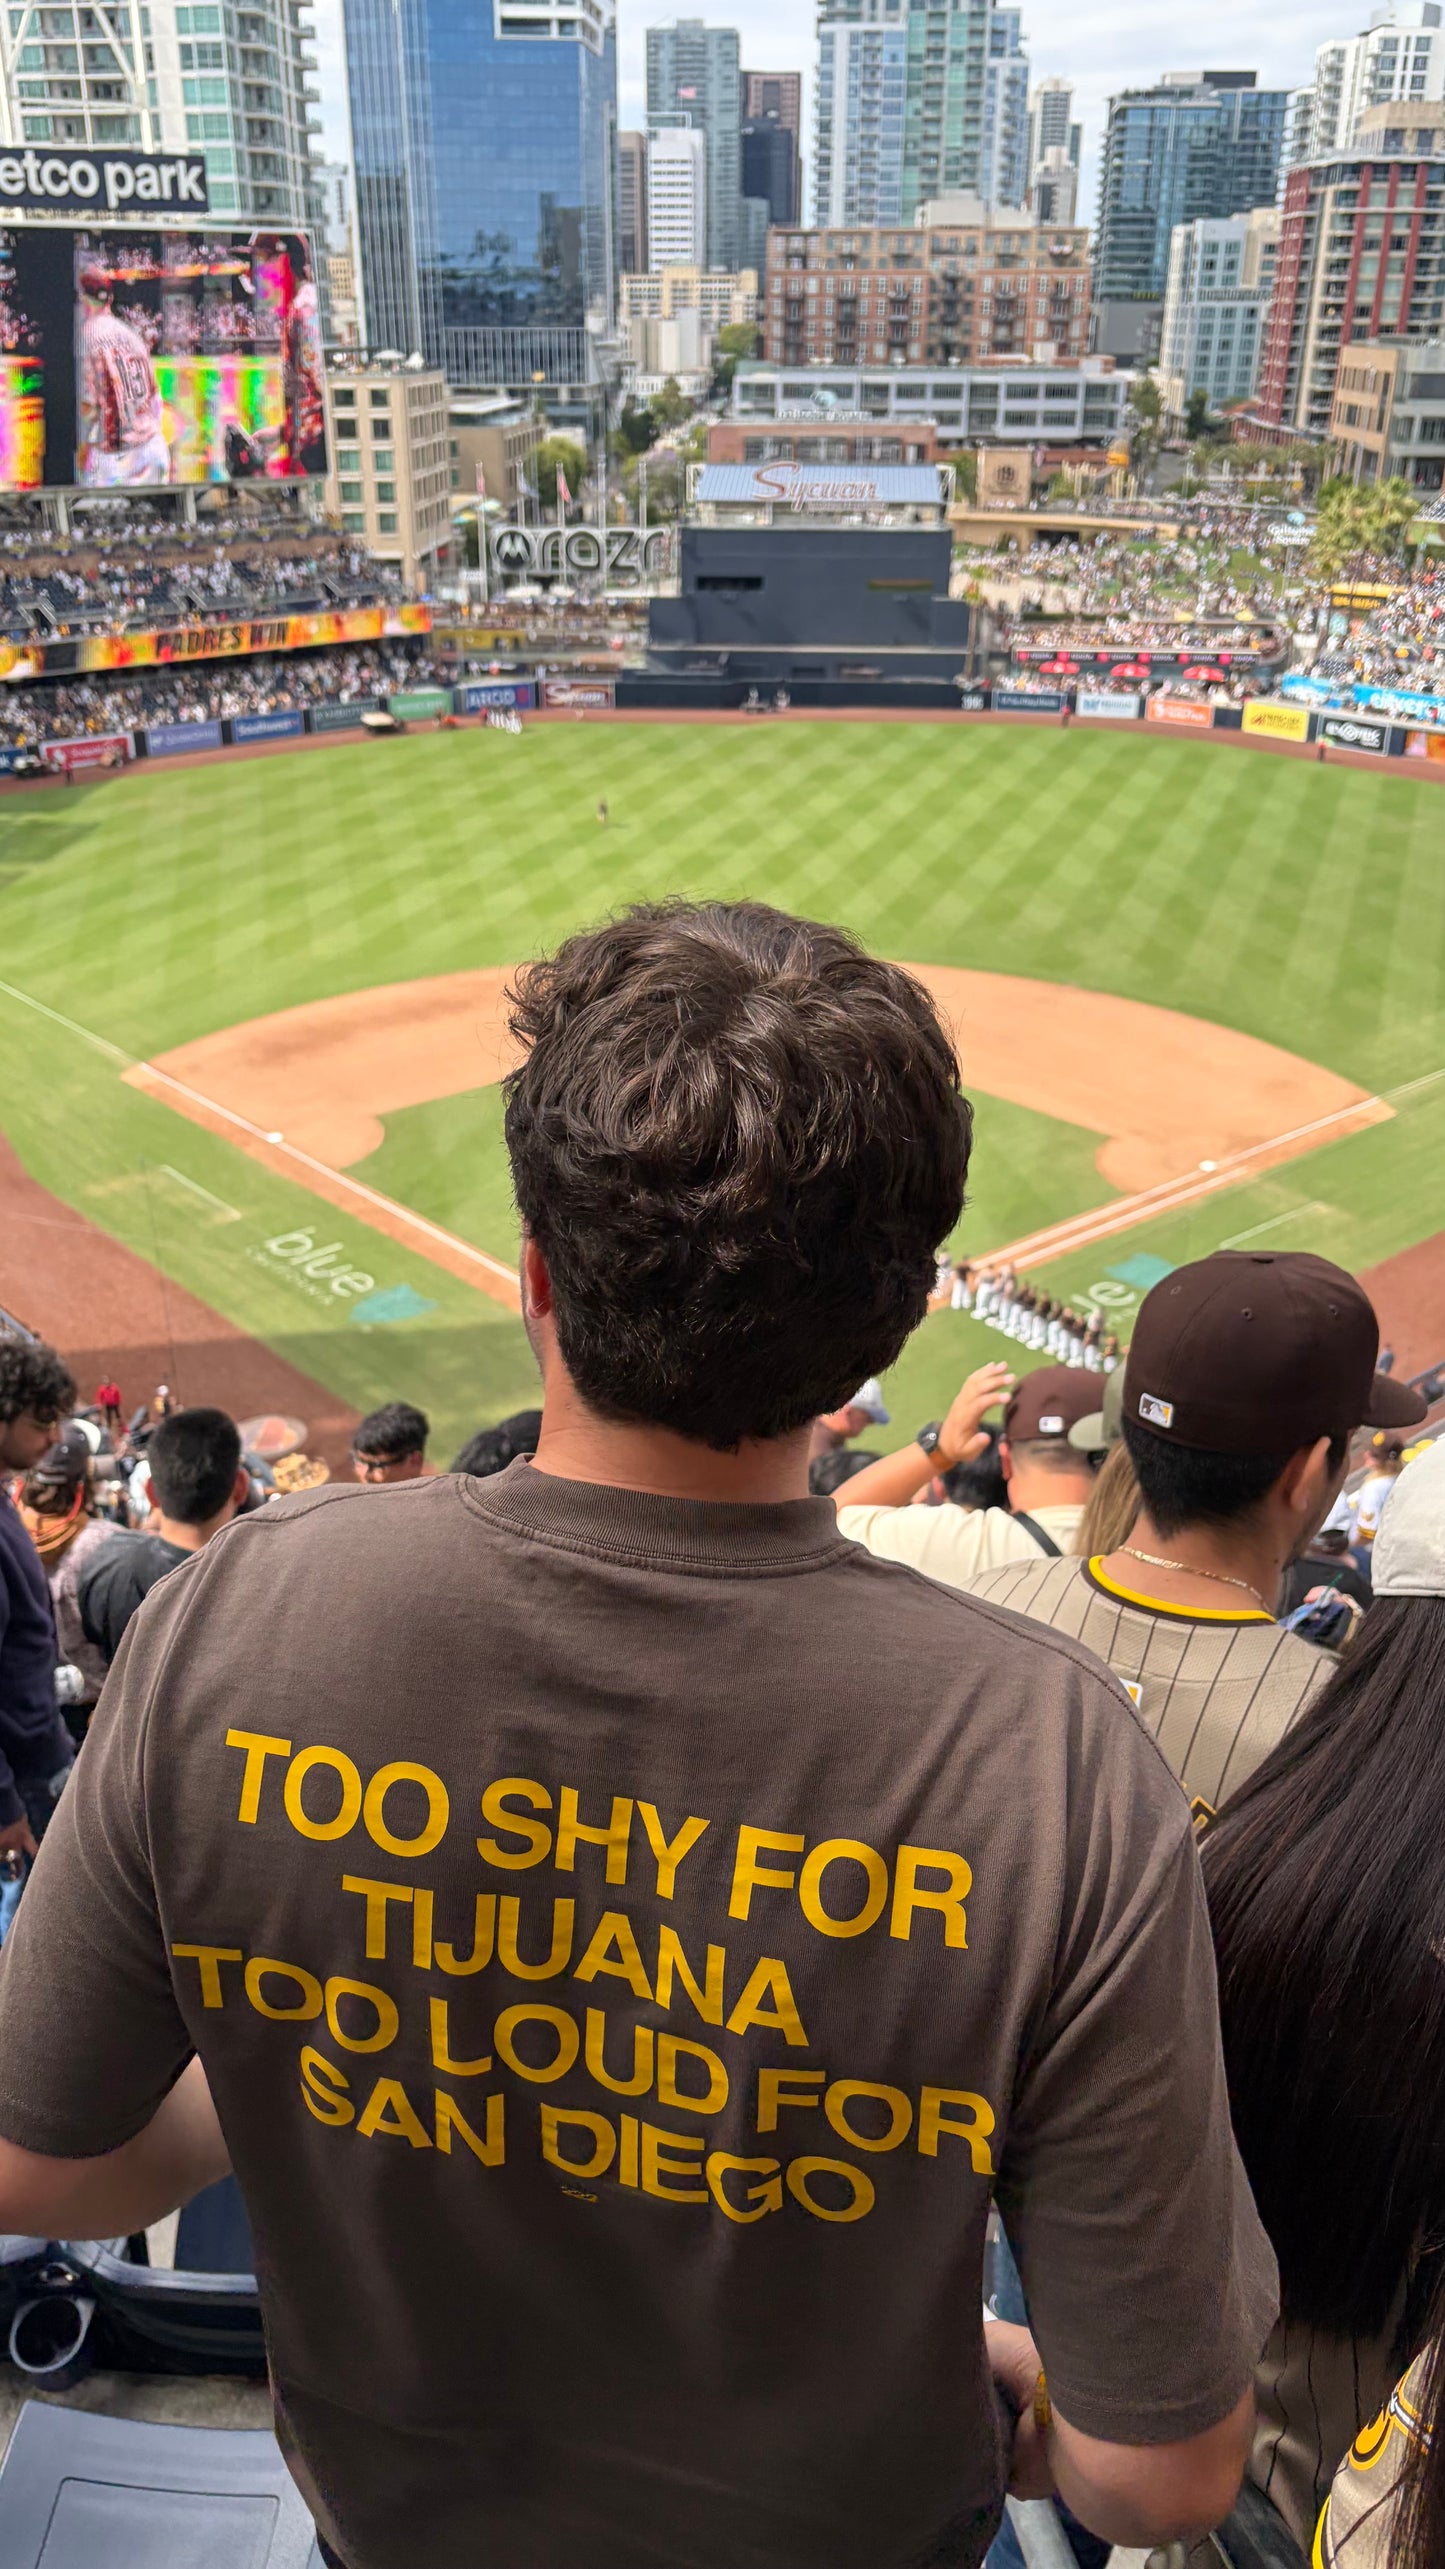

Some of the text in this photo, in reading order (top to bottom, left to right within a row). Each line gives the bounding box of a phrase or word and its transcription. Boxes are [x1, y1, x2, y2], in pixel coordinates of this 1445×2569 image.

[104, 159, 206, 210] park
[752, 460, 881, 512] Sycuan
[541, 530, 665, 570] razr
[156, 621, 289, 659] PADRES WIN
[265, 1225, 375, 1298] blue
[226, 1728, 973, 1950] TOO SHY FOR
[342, 1874, 809, 2047] TIJUANA
[172, 1943, 996, 2175] TOO LOUD FOR
[300, 2046, 875, 2223] SAN DIEGO
